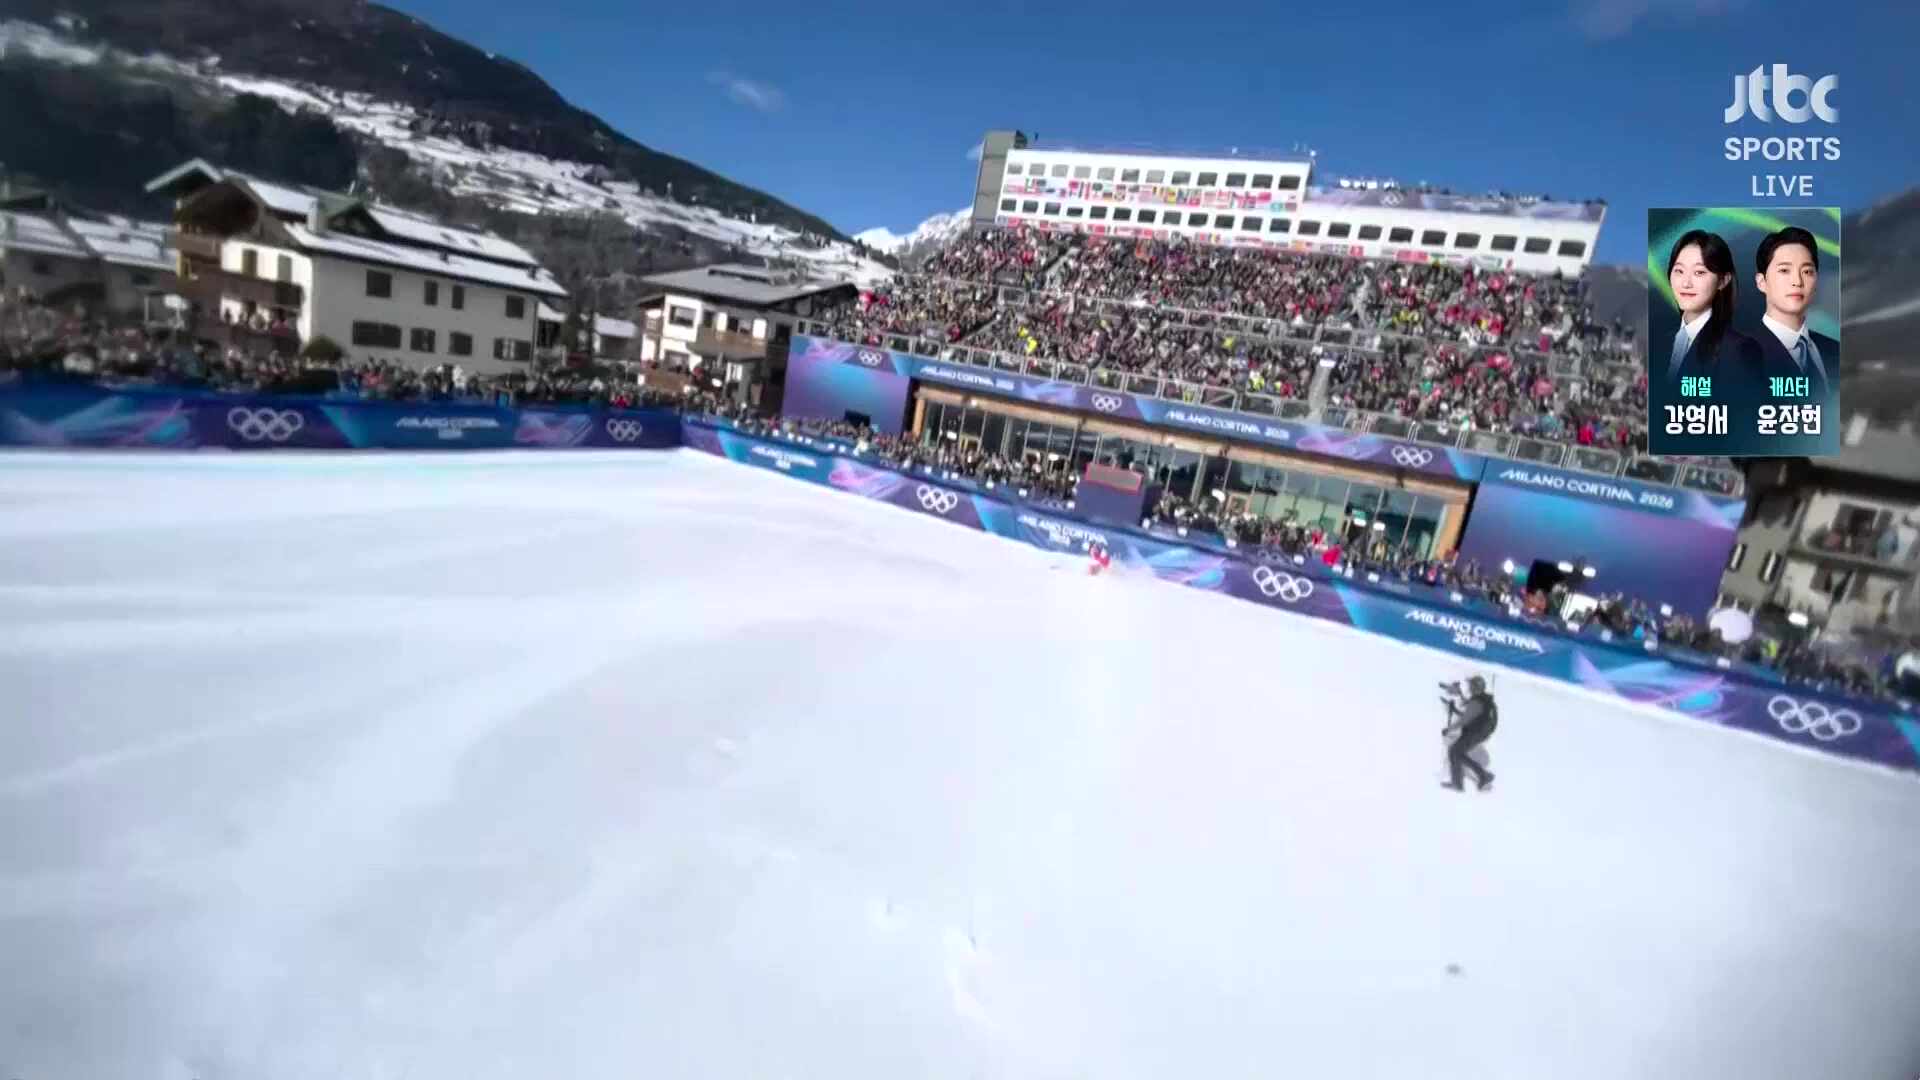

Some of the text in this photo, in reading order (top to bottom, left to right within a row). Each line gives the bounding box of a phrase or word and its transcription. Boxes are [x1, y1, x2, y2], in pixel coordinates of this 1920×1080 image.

[1166, 410, 1211, 425] MILANO
[1212, 417, 1261, 435] CORTINA
[1499, 468, 1673, 509] MILANO CORTINA 2026
[1404, 609, 1545, 654] MILANO CORTINA
